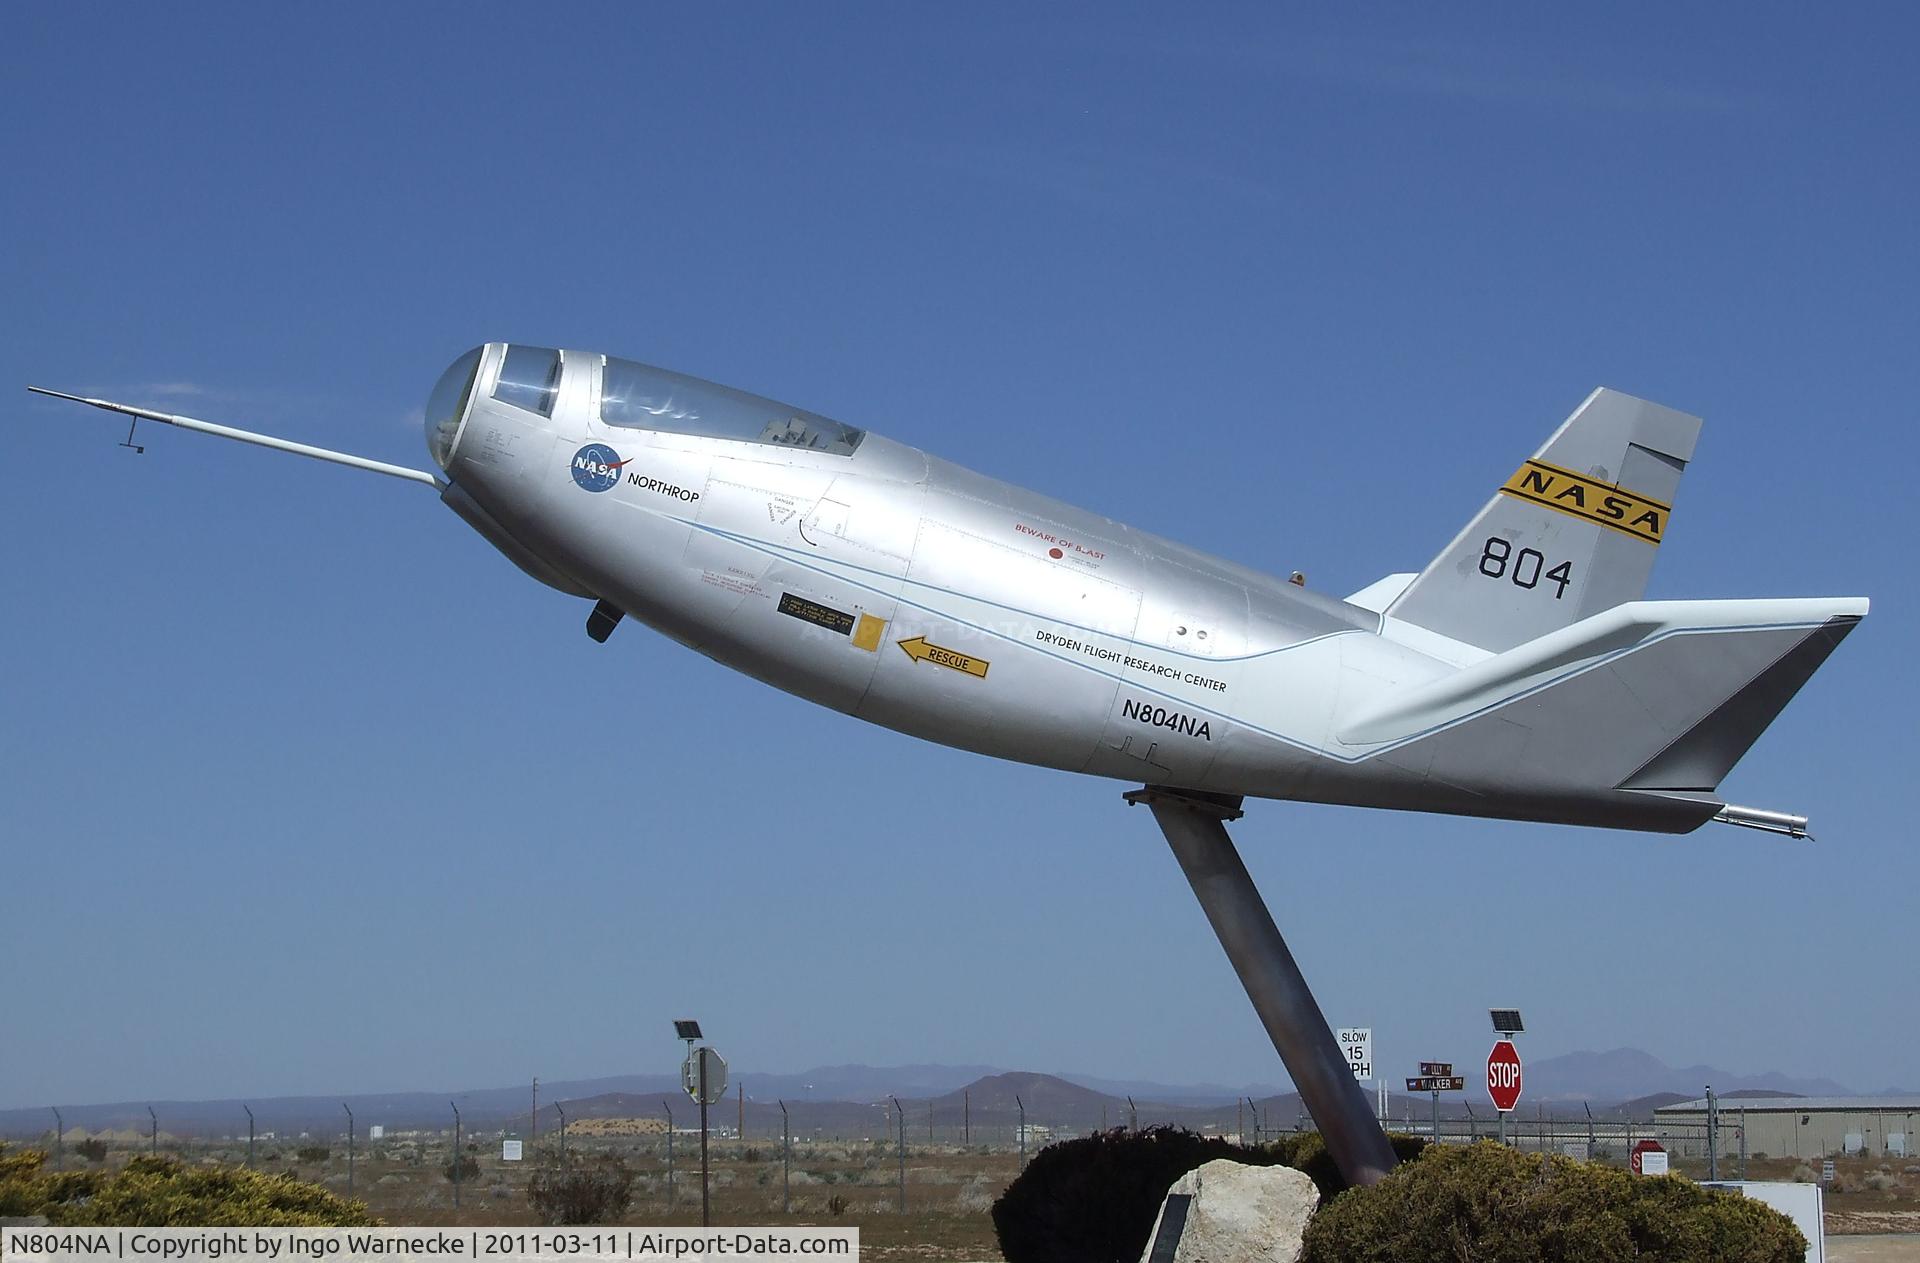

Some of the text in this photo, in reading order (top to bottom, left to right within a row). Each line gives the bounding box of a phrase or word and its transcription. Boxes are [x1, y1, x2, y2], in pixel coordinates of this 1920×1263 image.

[575, 456, 617, 480] NASA
[627, 472, 700, 503] NORTHROP
[1519, 469, 1661, 535] NASA
[1015, 523, 1106, 560] BEWARE OF BLAST
[1479, 536, 1573, 600] 804
[928, 648, 970, 670] RESCUE
[1035, 630, 1227, 692] DRYDEN FLIGHT RESEARCH CENTER
[1122, 699, 1211, 741] N804NA
[1341, 1032, 1367, 1043] SLOW
[1347, 1045, 1364, 1060] 15
[1421, 1078, 1451, 1090] WALKER
[1489, 1062, 1519, 1088] STOP
